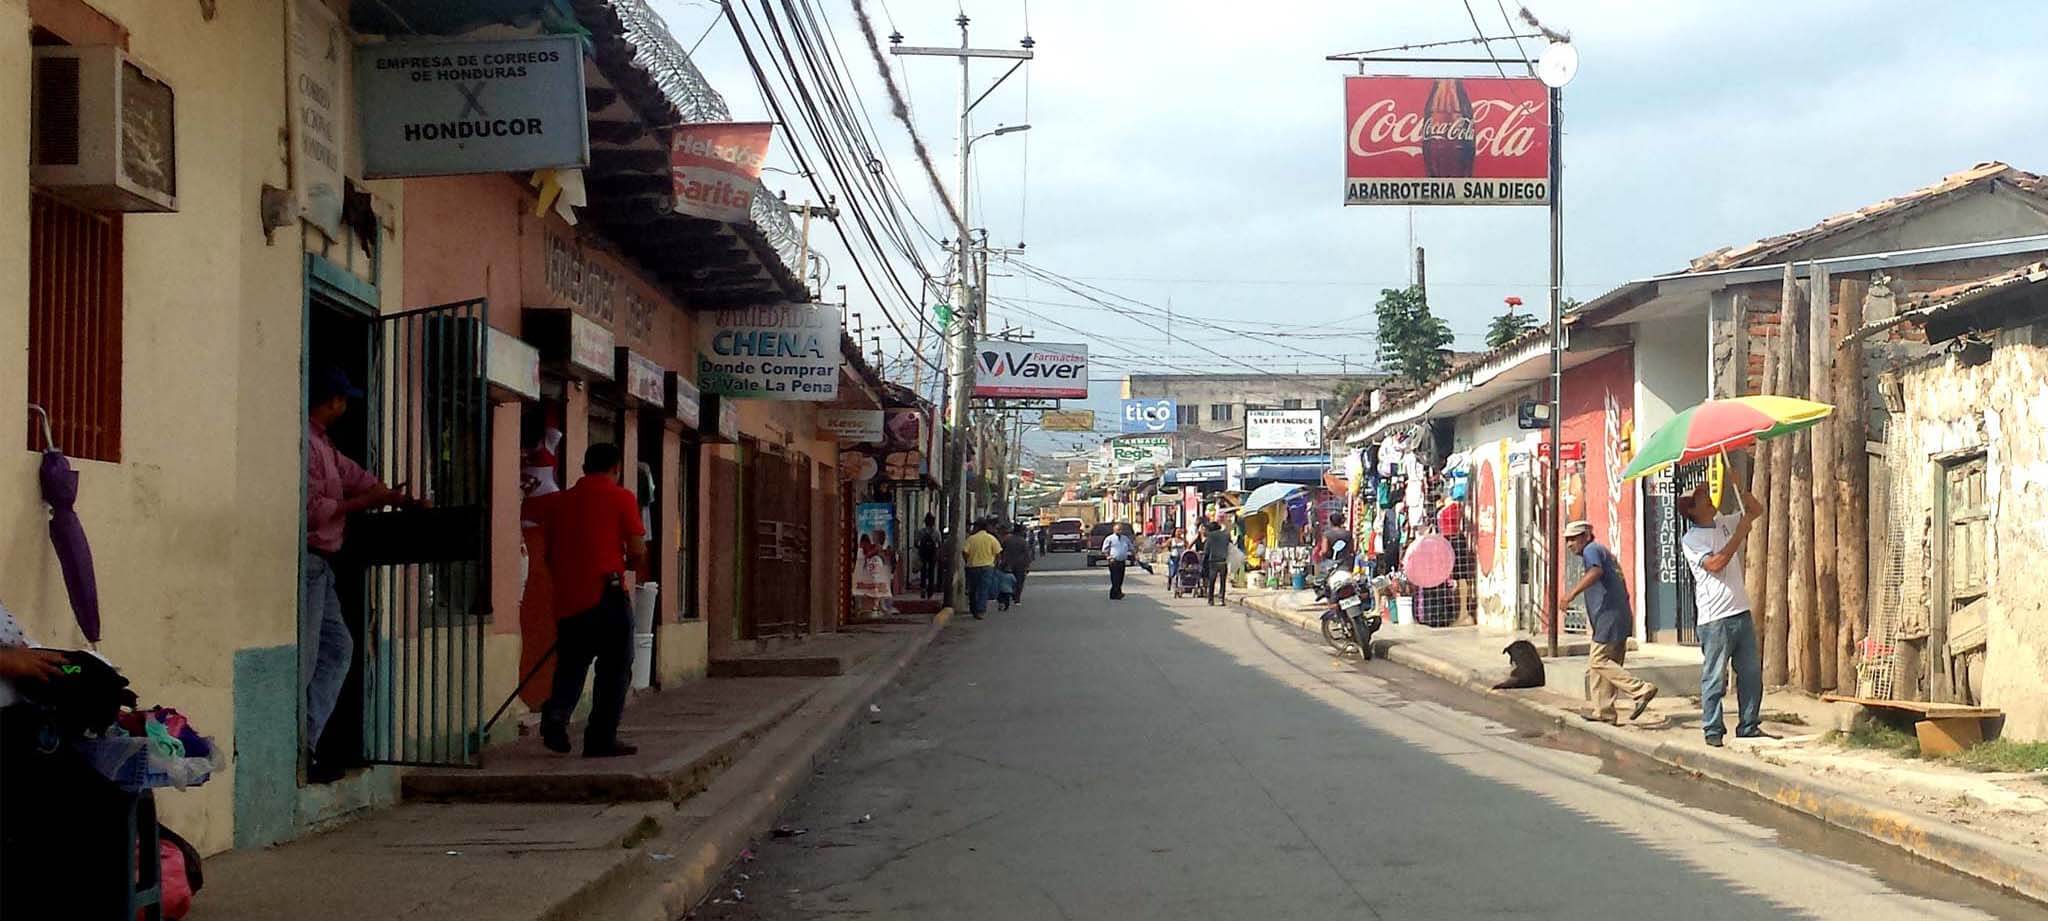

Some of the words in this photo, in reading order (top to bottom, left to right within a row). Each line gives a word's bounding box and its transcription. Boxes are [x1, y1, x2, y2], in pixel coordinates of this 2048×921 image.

[376, 55, 453, 70] EMPRESA
[458, 56, 479, 66] DE
[483, 51, 560, 64] CORREOS
[411, 68, 432, 81] DE
[437, 66, 527, 80] HONDURAS
[404, 118, 543, 141] HONDUCOR
[674, 133, 761, 170] Helados
[672, 171, 749, 209] Sarita
[1350, 182, 1456, 199] ABARROTERIA
[1463, 182, 1493, 199] SAN
[1499, 182, 1545, 199] DIEGO
[712, 331, 824, 358] CHENA
[701, 361, 755, 374] Donde
[761, 362, 833, 378] Comprar
[1005, 352, 1085, 379] Vaver
[723, 378, 759, 391] Vale
[765, 379, 785, 391] La
